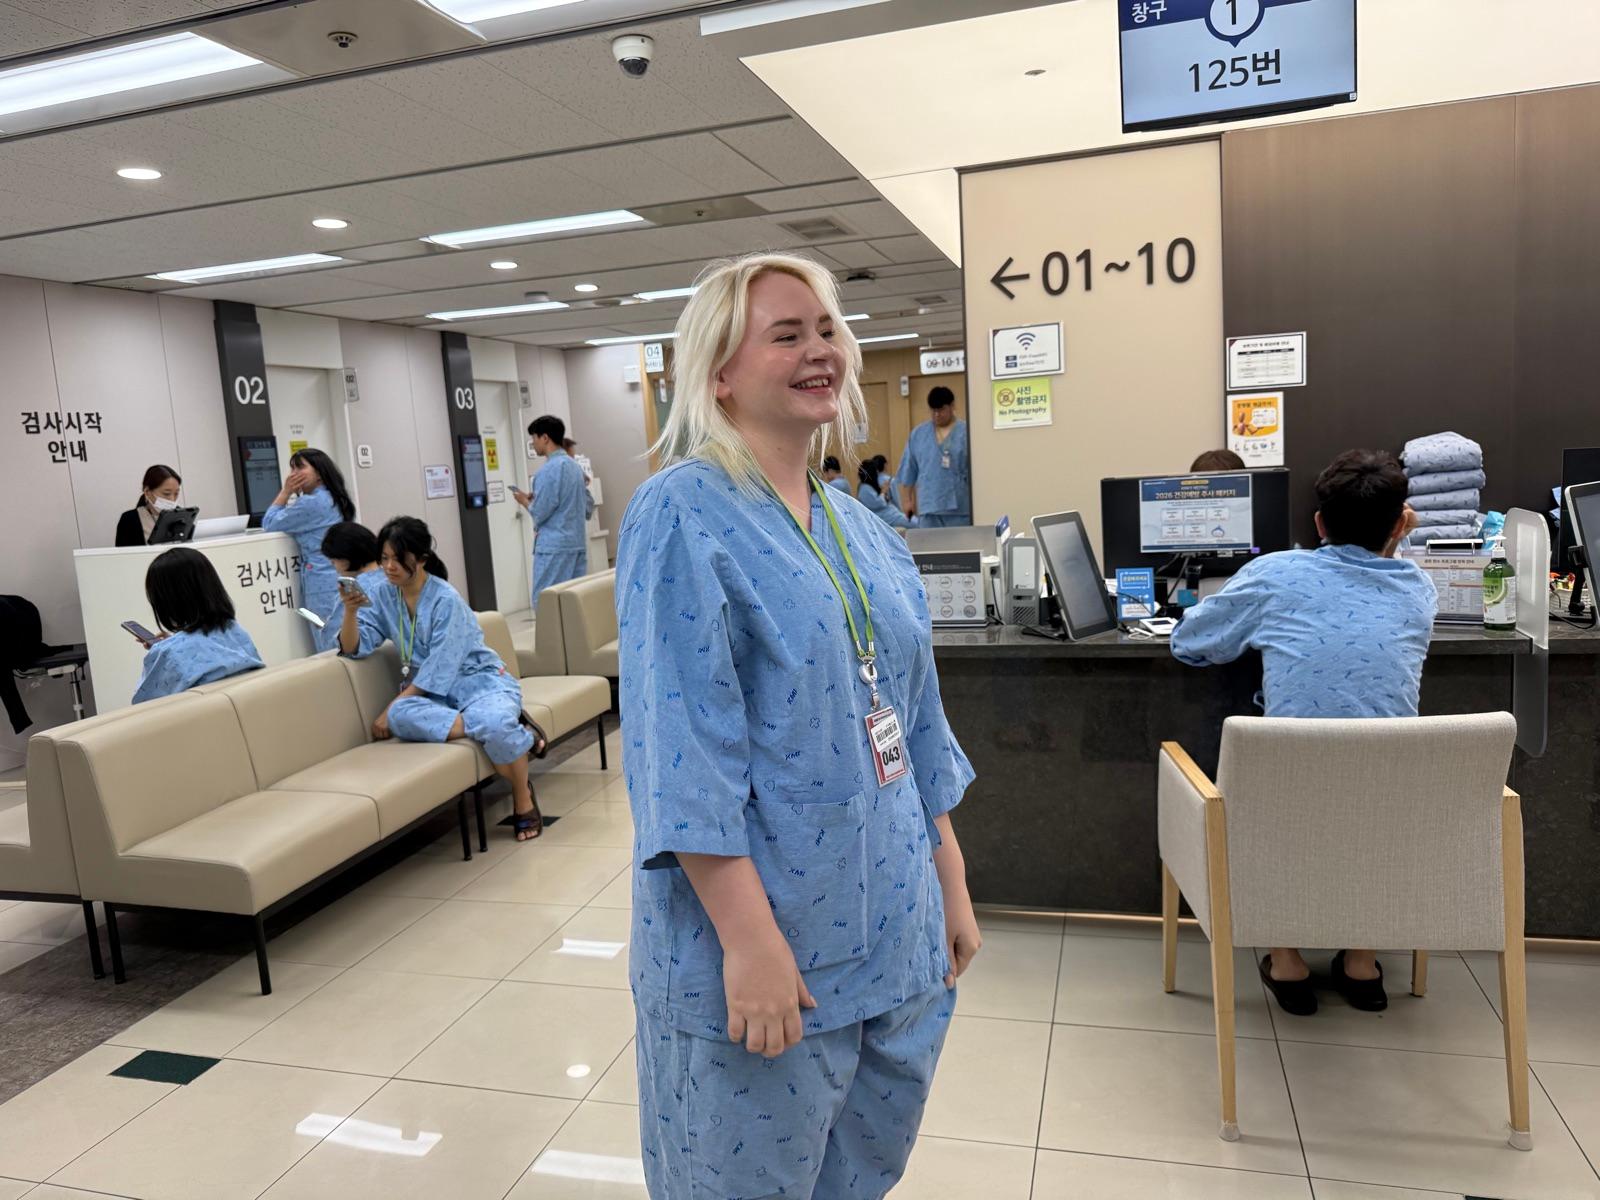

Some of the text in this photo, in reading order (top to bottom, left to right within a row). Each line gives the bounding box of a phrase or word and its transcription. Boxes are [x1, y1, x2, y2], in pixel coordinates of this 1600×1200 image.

[1131, 0, 1168, 24] 창구
[1225, 0, 1237, 26] 1
[1188, 48, 1282, 93] 125번
[1041, 236, 1196, 296] 01~10
[646, 345, 660, 357] 04
[234, 375, 266, 405] 02
[455, 386, 474, 410] 03
[1016, 385, 1031, 395] 사진
[1016, 395, 1047, 406] 촬영금지
[1008, 406, 1047, 415] Photography
[21, 411, 103, 435] 검사시작
[47, 438, 89, 464] 안내
[360, 447, 369, 457] 02
[260, 586, 294, 615] 안내
[882, 746, 900, 766] 043
